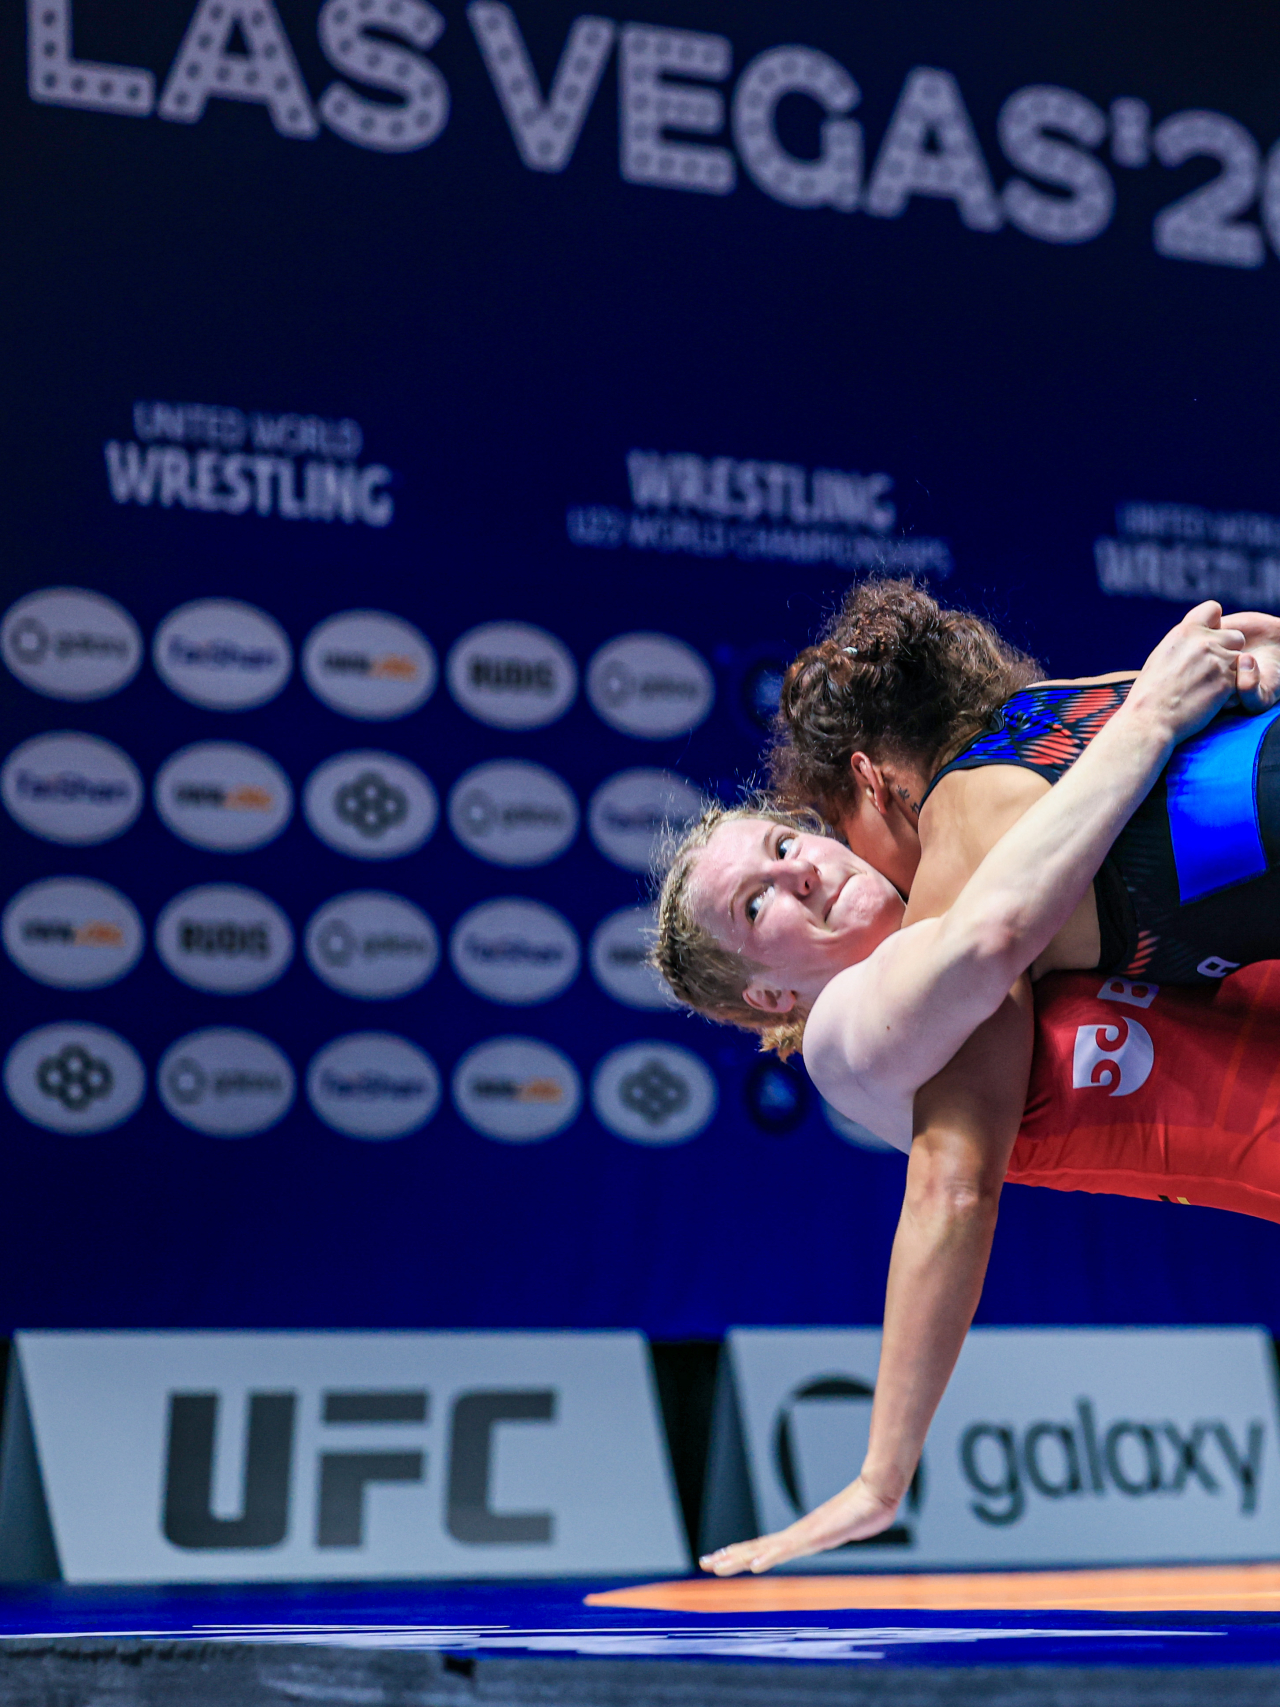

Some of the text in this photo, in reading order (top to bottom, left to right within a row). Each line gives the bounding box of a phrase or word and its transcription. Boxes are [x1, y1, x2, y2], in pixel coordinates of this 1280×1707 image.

[27, 0, 451, 154] LAS
[104, 438, 394, 528] WRESTLING
[132, 400, 364, 460] UNITED WORLD
[626, 448, 898, 534] WRESTLING
[161, 1387, 558, 1551] UFC
[958, 1395, 1265, 1527] galaxy
